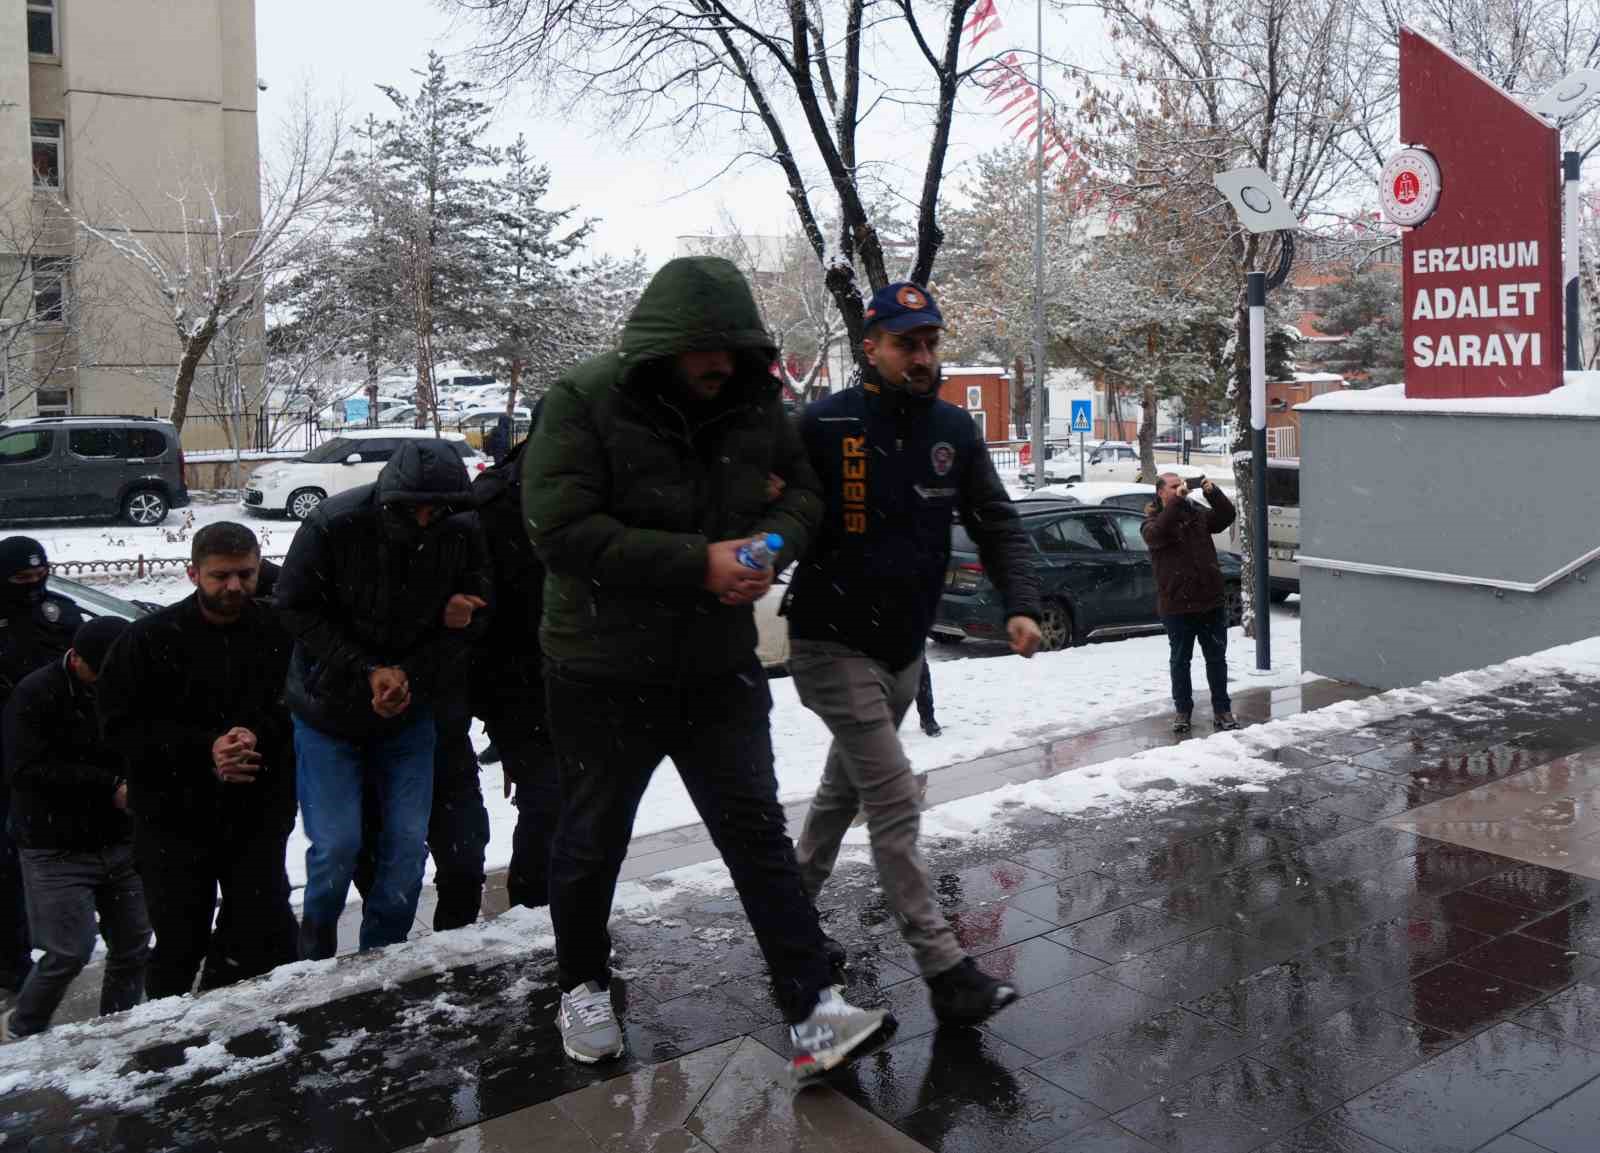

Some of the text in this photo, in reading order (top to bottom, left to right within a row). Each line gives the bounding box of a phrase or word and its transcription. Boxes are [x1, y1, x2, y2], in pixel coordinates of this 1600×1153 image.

[1413, 240, 1539, 274] ERZURUM
[1412, 283, 1541, 321] ADALET
[1413, 334, 1541, 368] SARAYI
